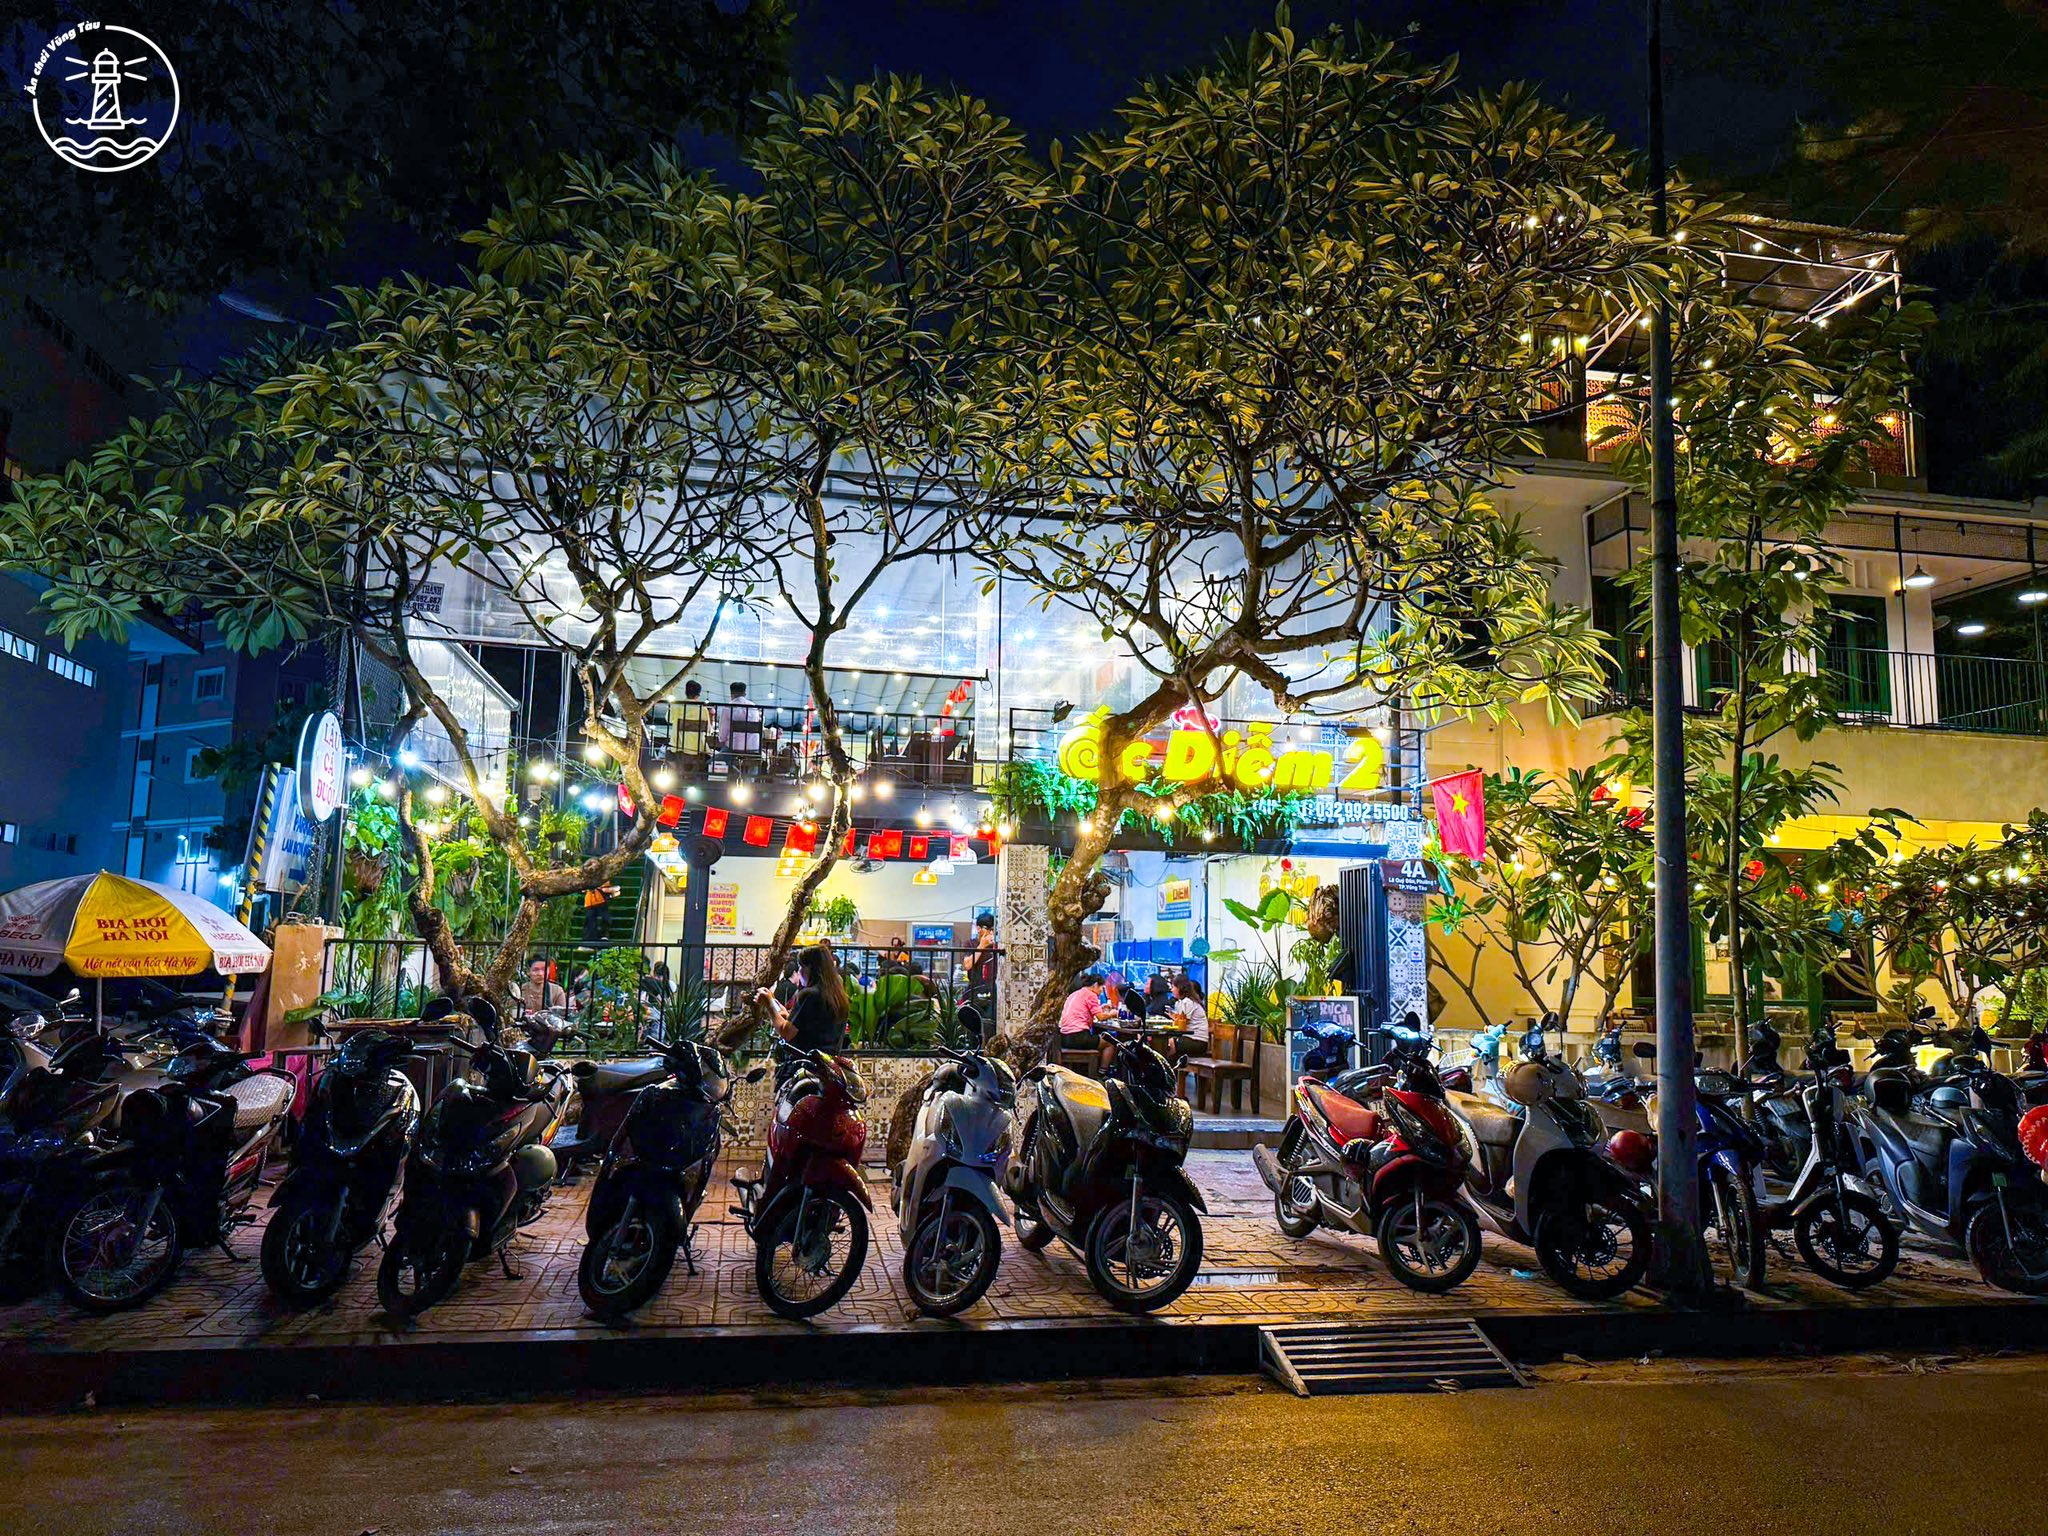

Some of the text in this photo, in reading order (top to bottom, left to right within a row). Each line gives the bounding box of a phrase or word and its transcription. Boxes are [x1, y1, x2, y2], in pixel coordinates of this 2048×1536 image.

[1163, 721, 1333, 788] Diễm
[1339, 736, 1384, 790] 2
[1316, 802, 1342, 820] 032
[1344, 803, 1371, 821] 992
[1373, 804, 1409, 822] 5500
[1401, 860, 1426, 878] 4A
[96, 916, 168, 929] BIA HƠI
[102, 928, 169, 943] HÀ NỘI
[17, 953, 45, 971] NỘI
[83, 955, 199, 971] Một nét văn hóa Hà Nội
